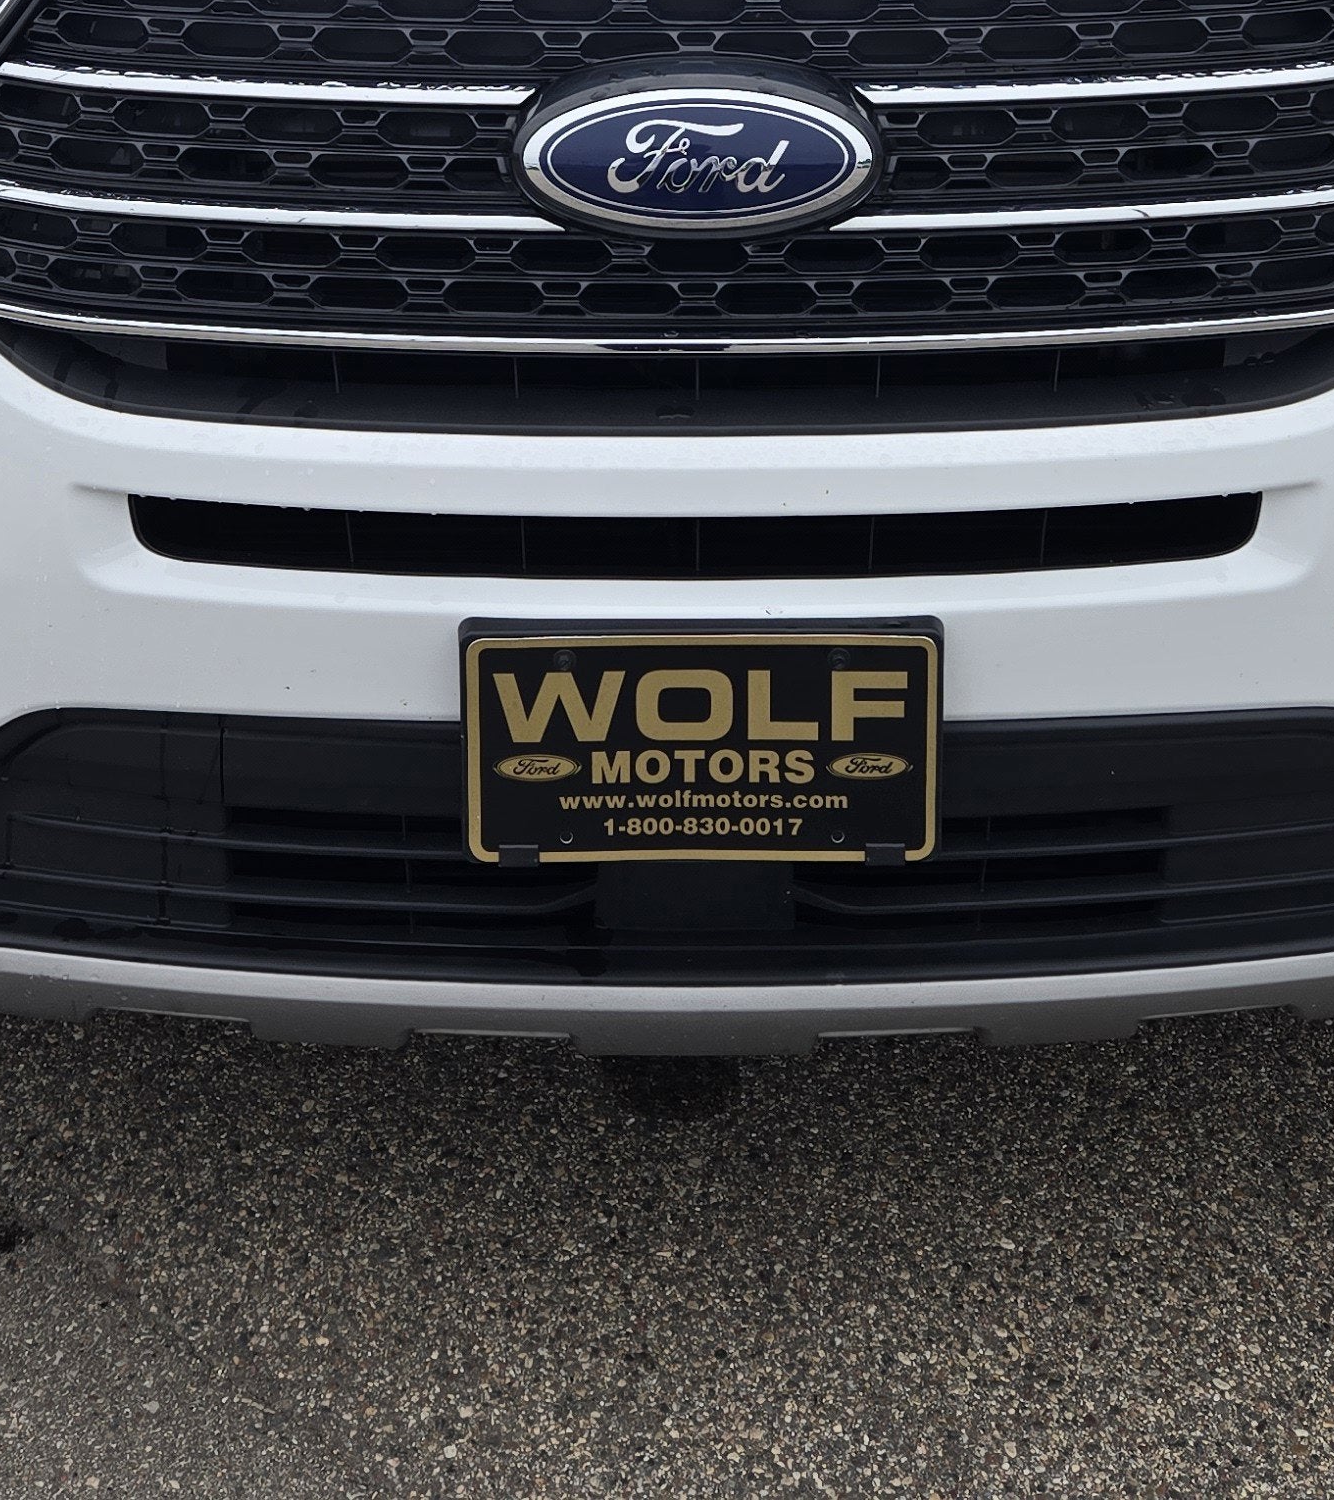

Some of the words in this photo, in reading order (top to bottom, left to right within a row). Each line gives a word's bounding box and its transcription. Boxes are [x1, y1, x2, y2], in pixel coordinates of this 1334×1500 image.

[607, 119, 790, 194] Ford
[492, 669, 908, 743] WOLF
[512, 757, 562, 777] Ford
[591, 749, 814, 784] MOTORS
[844, 755, 894, 776] Ford
[559, 790, 848, 810] www.wolfmotors.com
[603, 817, 803, 836] 1-800-830-0017
